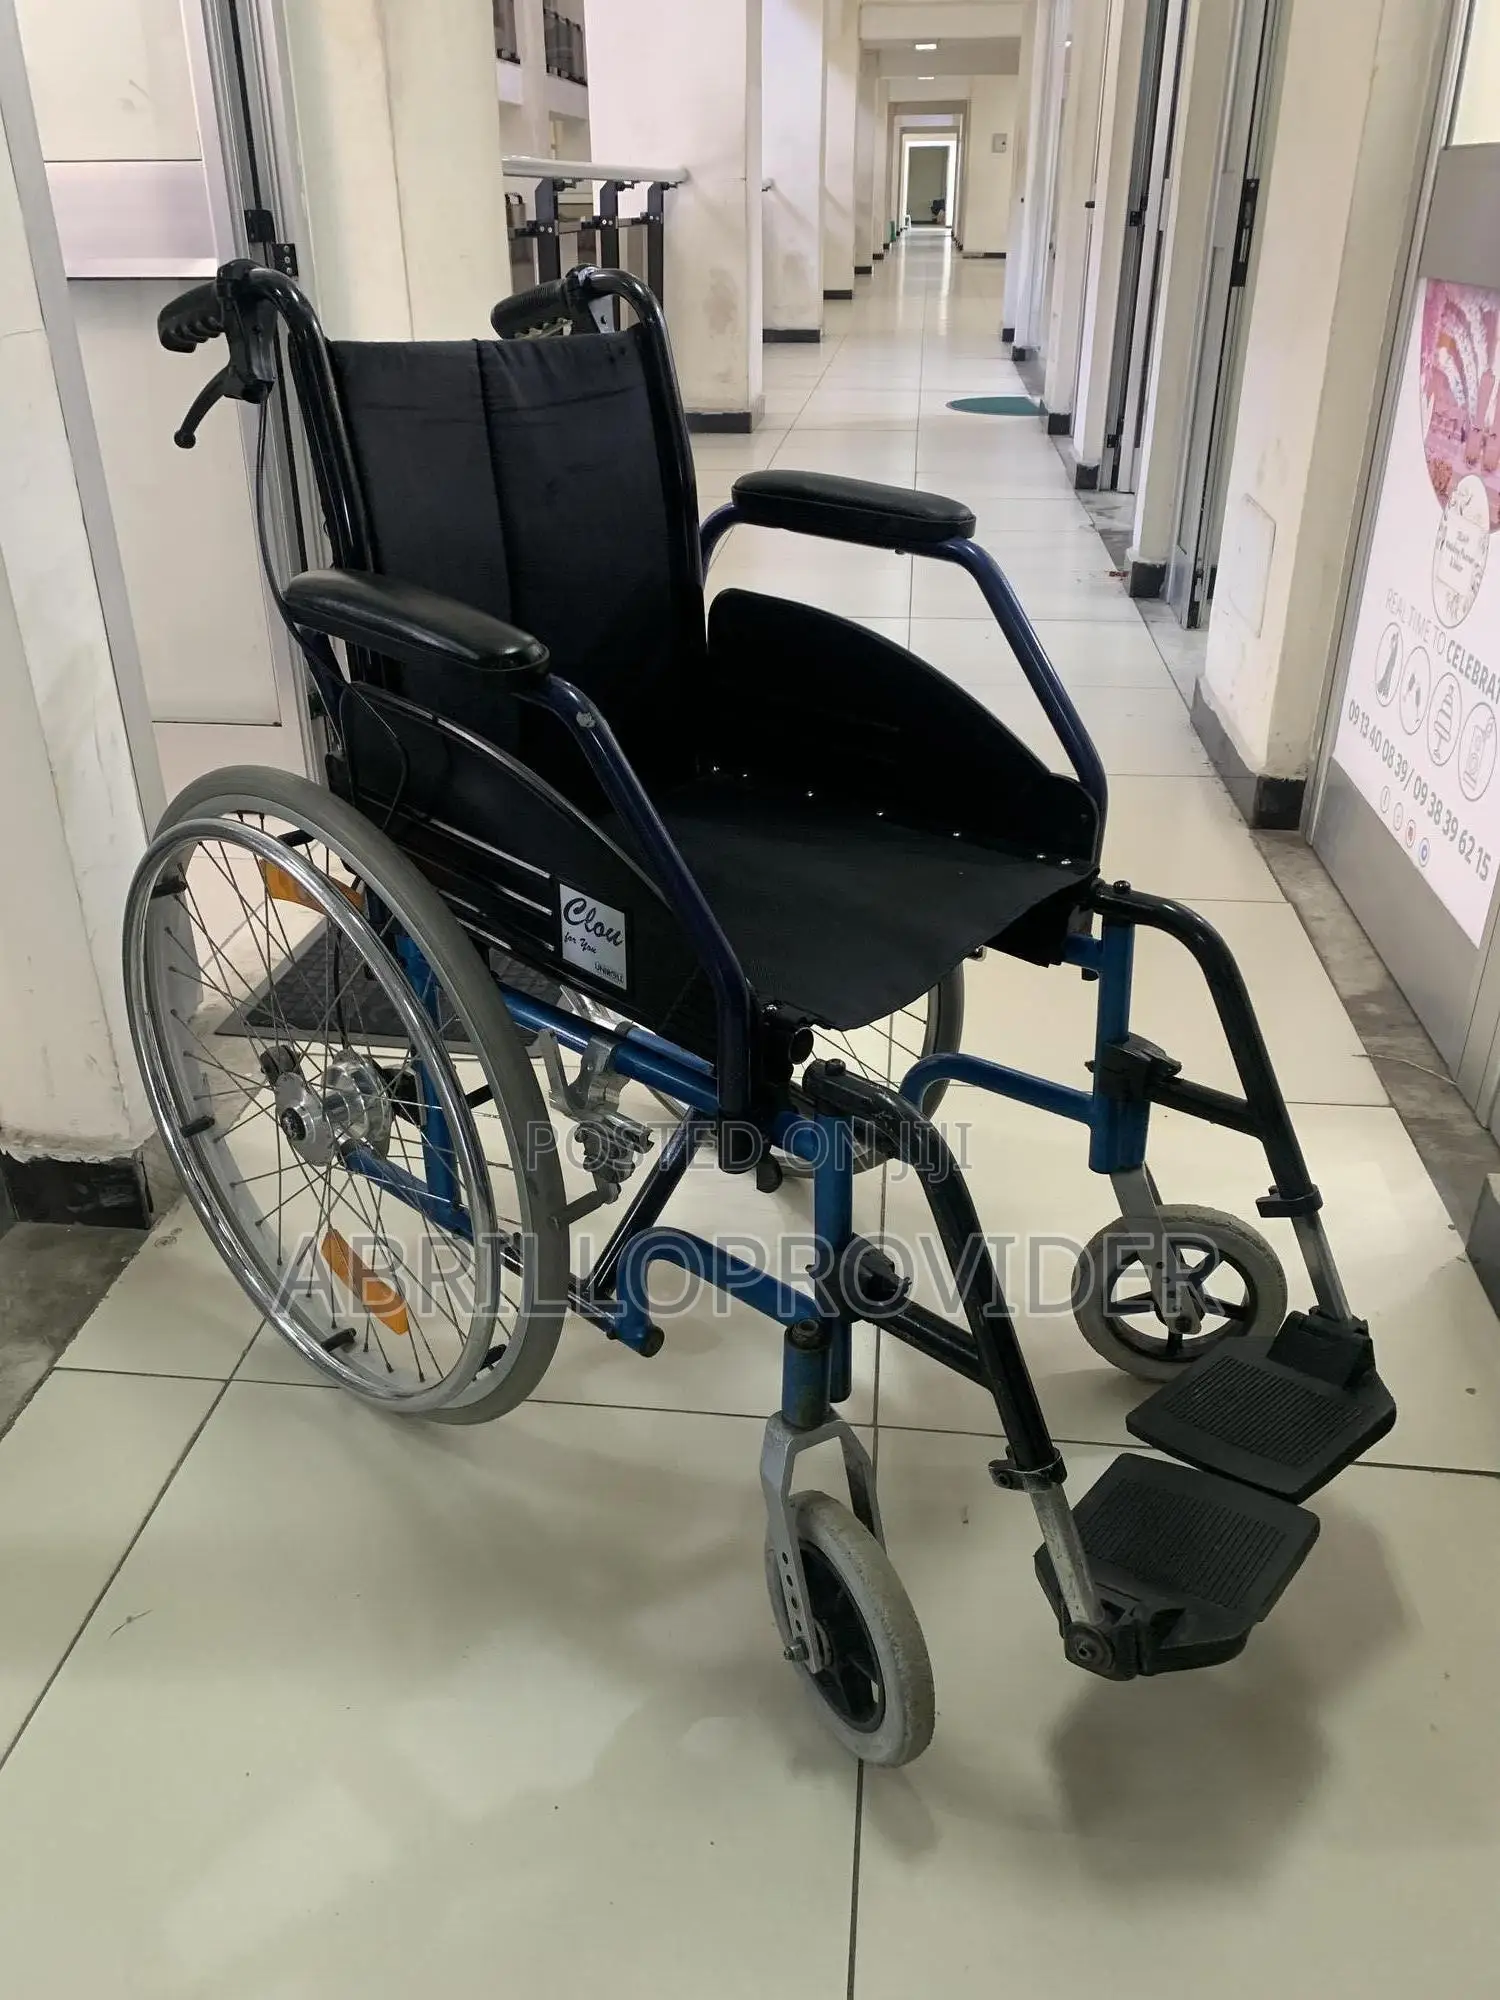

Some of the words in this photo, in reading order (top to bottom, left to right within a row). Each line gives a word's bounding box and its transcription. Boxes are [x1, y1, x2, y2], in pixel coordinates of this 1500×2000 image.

[1408, 605, 1432, 644] TIME
[1432, 625, 1447, 655] TO
[563, 897, 623, 947] Clou
[564, 931, 577, 944] for
[579, 937, 597, 954] You
